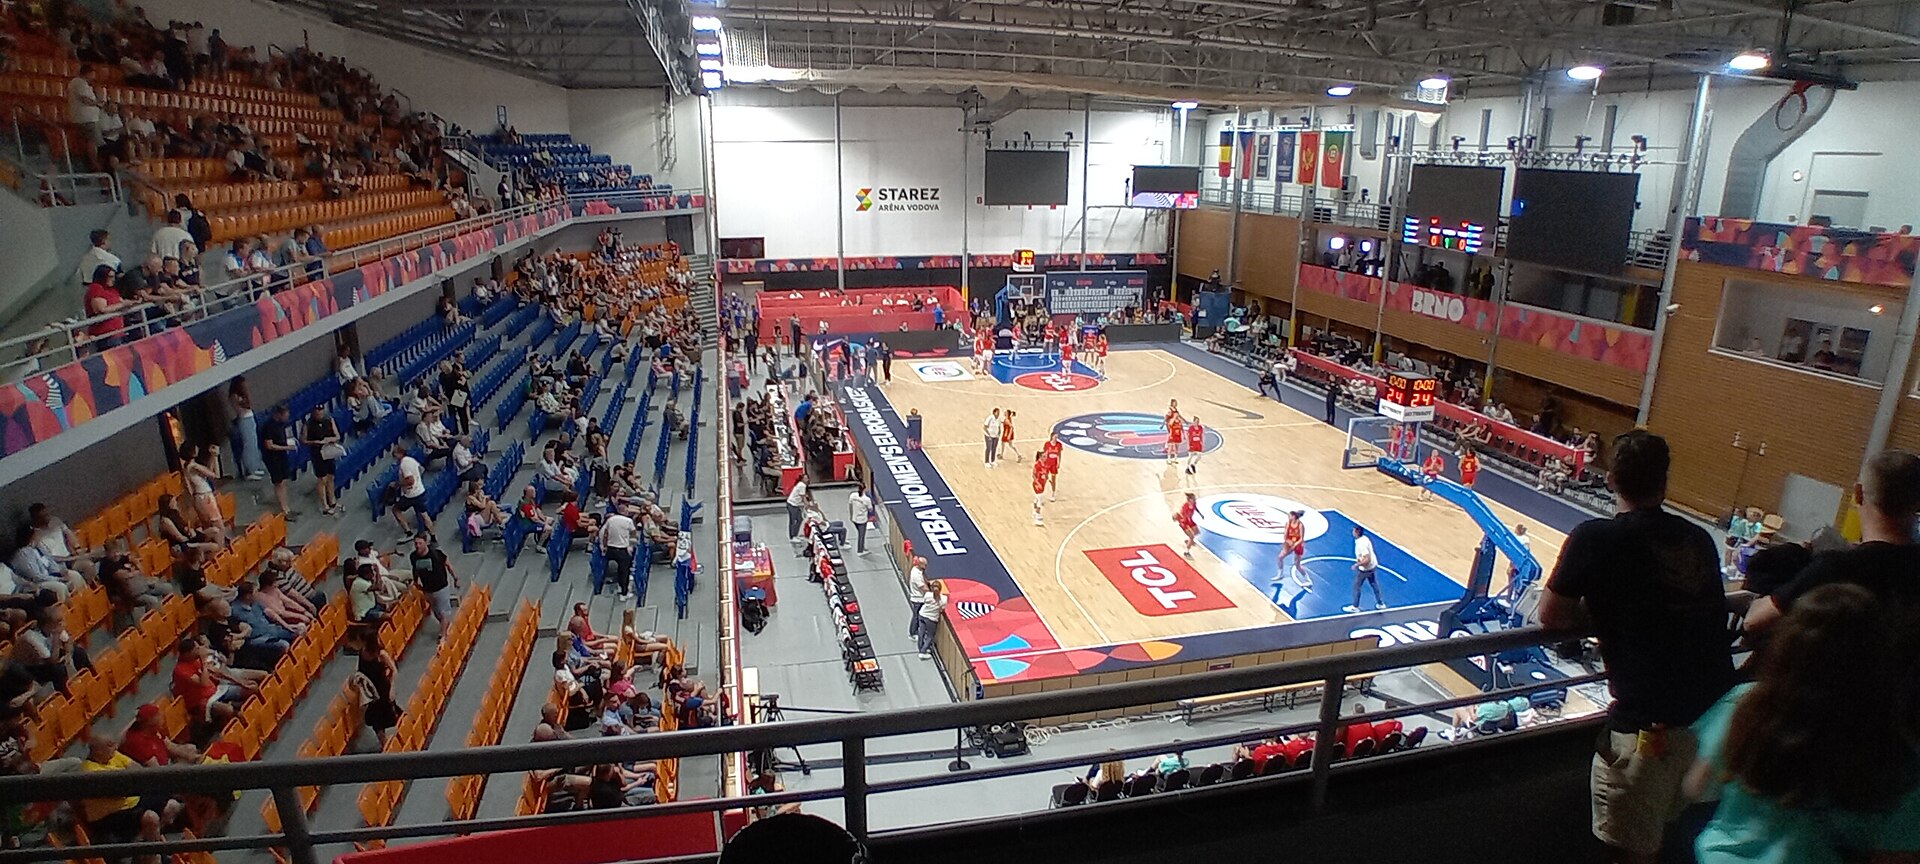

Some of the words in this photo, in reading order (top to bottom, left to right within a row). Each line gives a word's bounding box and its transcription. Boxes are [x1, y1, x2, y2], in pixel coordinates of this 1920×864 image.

[878, 188, 940, 201] STAREZ
[908, 203, 940, 212] VODOVA
[1411, 289, 1465, 322] BRNO
[1412, 379, 1436, 391] 10:00
[1386, 388, 1404, 404] 24
[1410, 393, 1431, 408] 24
[879, 445, 938, 509] WOMEN'S
[914, 507, 968, 556] FIBA
[1120, 549, 1197, 609] TCL
